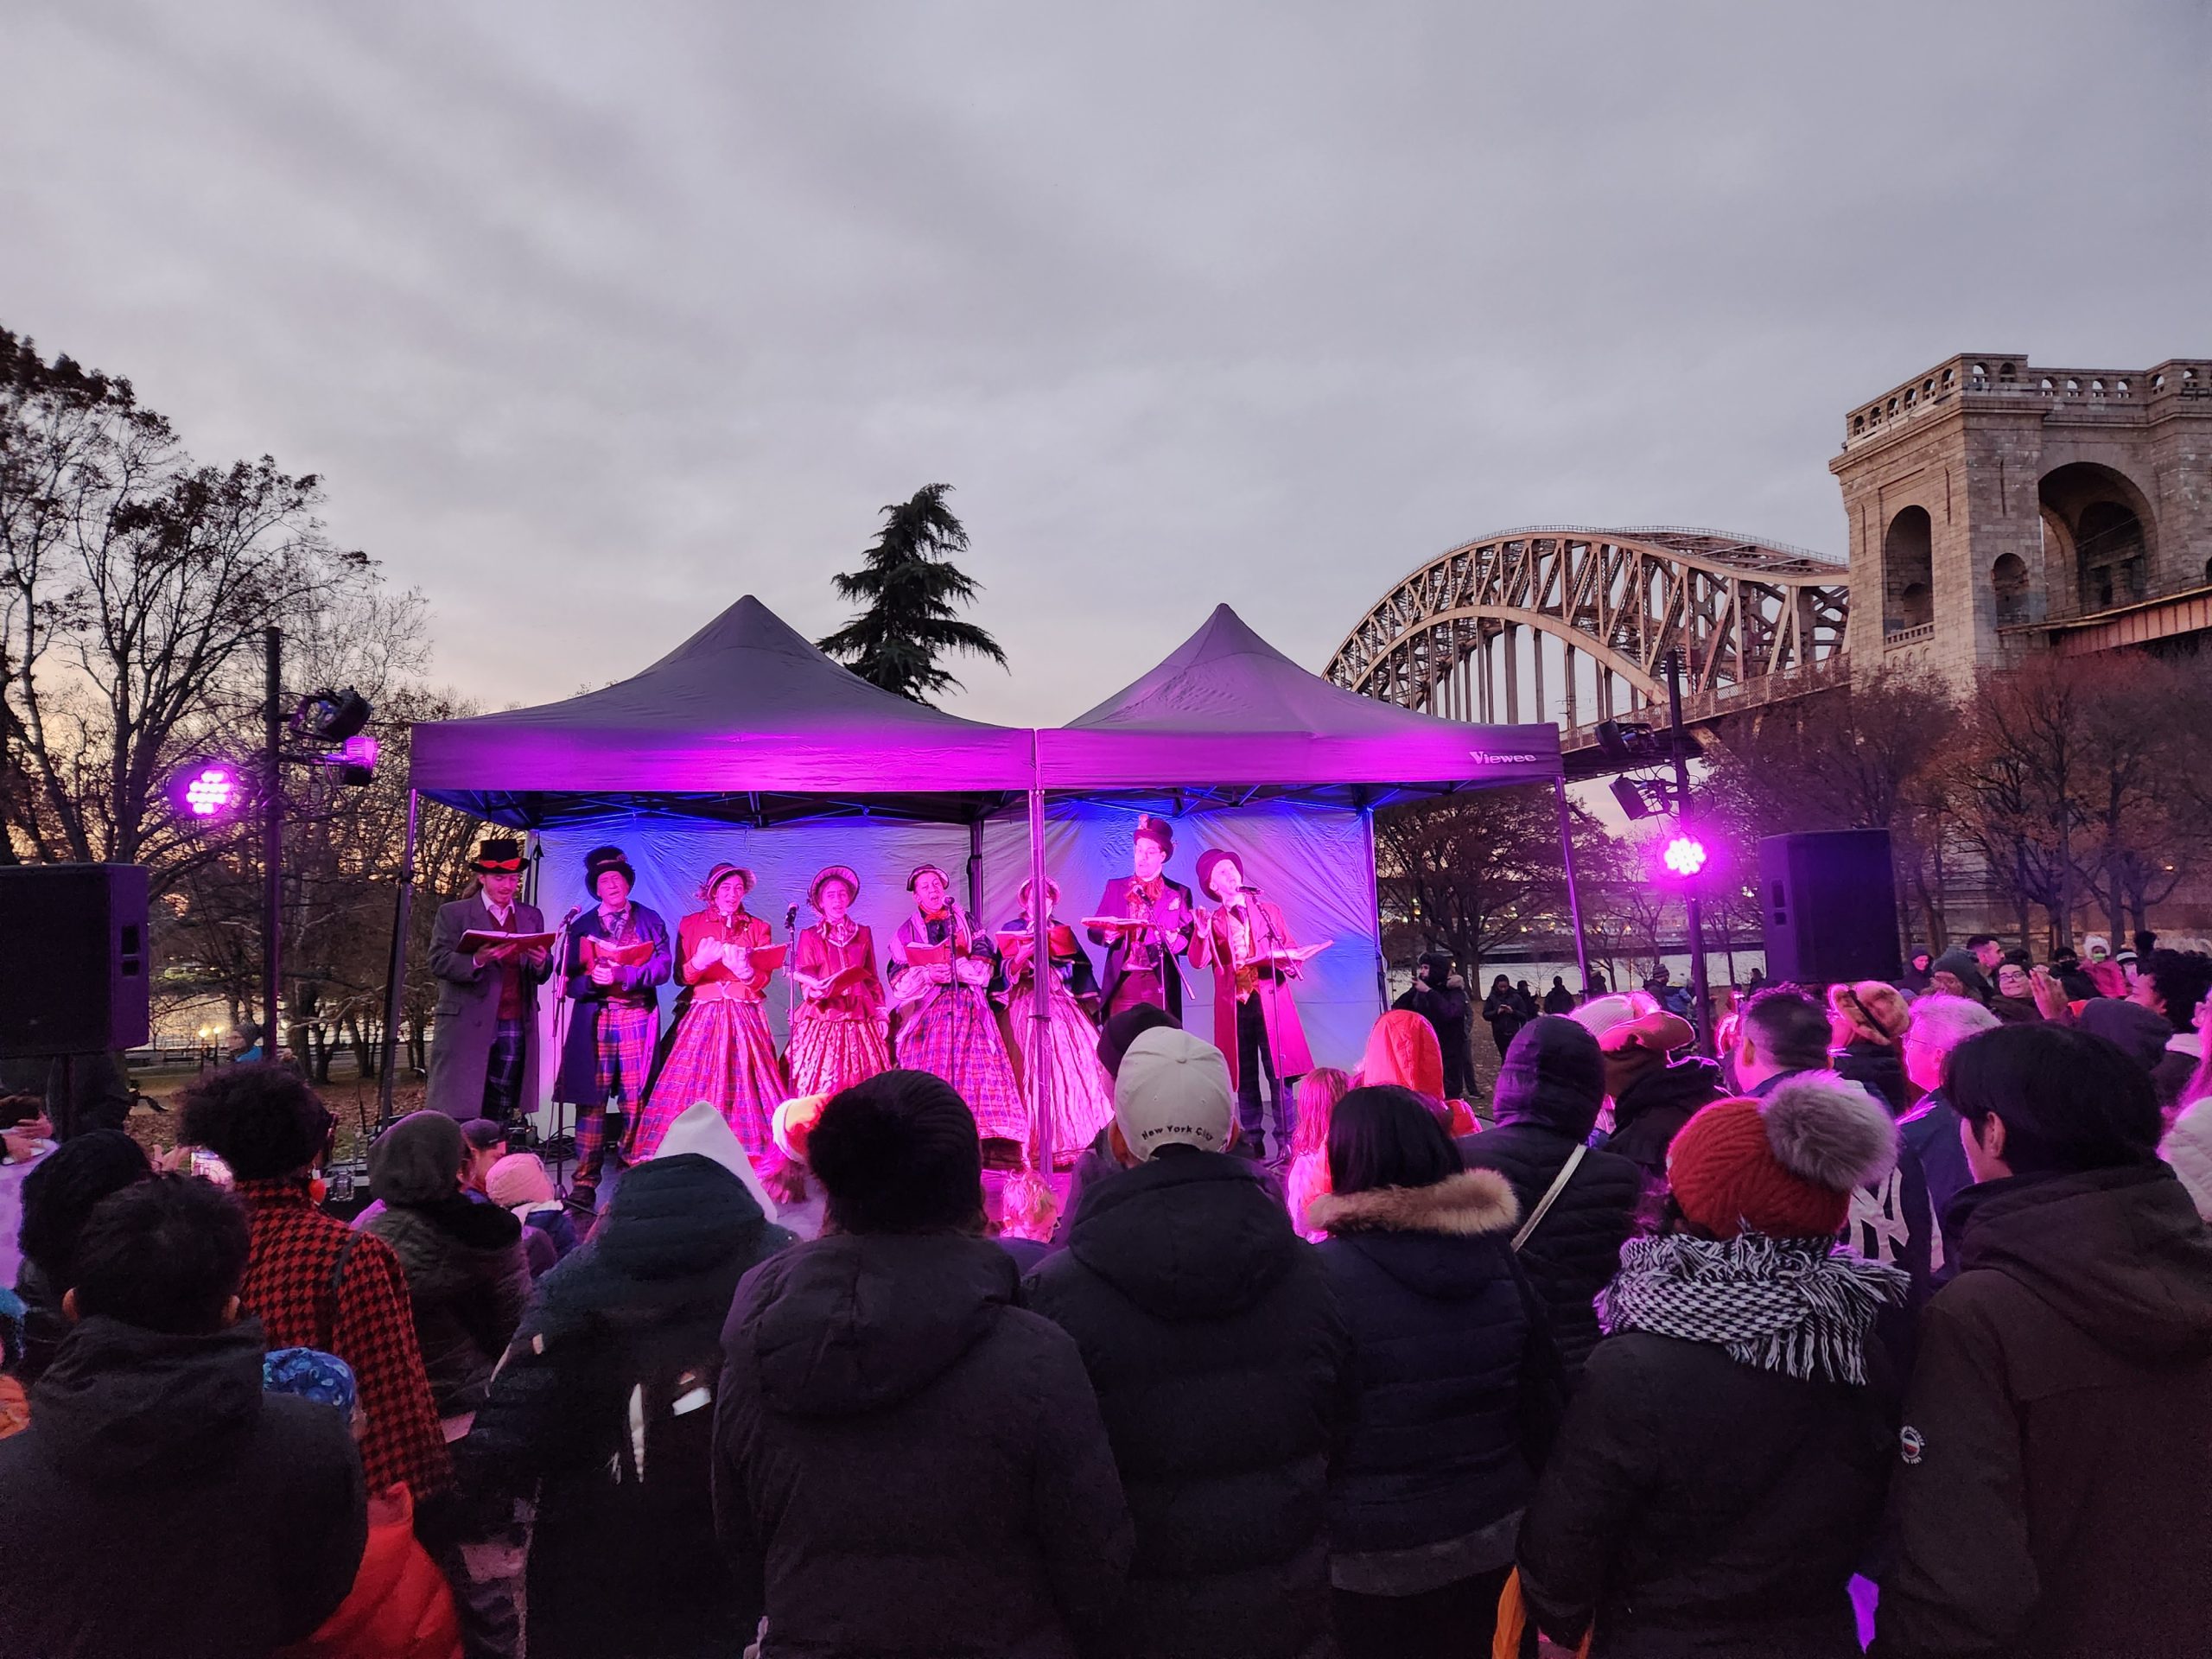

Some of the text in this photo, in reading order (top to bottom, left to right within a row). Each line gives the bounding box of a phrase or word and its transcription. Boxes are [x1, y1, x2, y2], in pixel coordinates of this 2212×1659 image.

[2177, 388, 2212, 402] SP
[1469, 751, 1536, 764] Viewee
[1141, 1125, 1213, 1141] New York City
